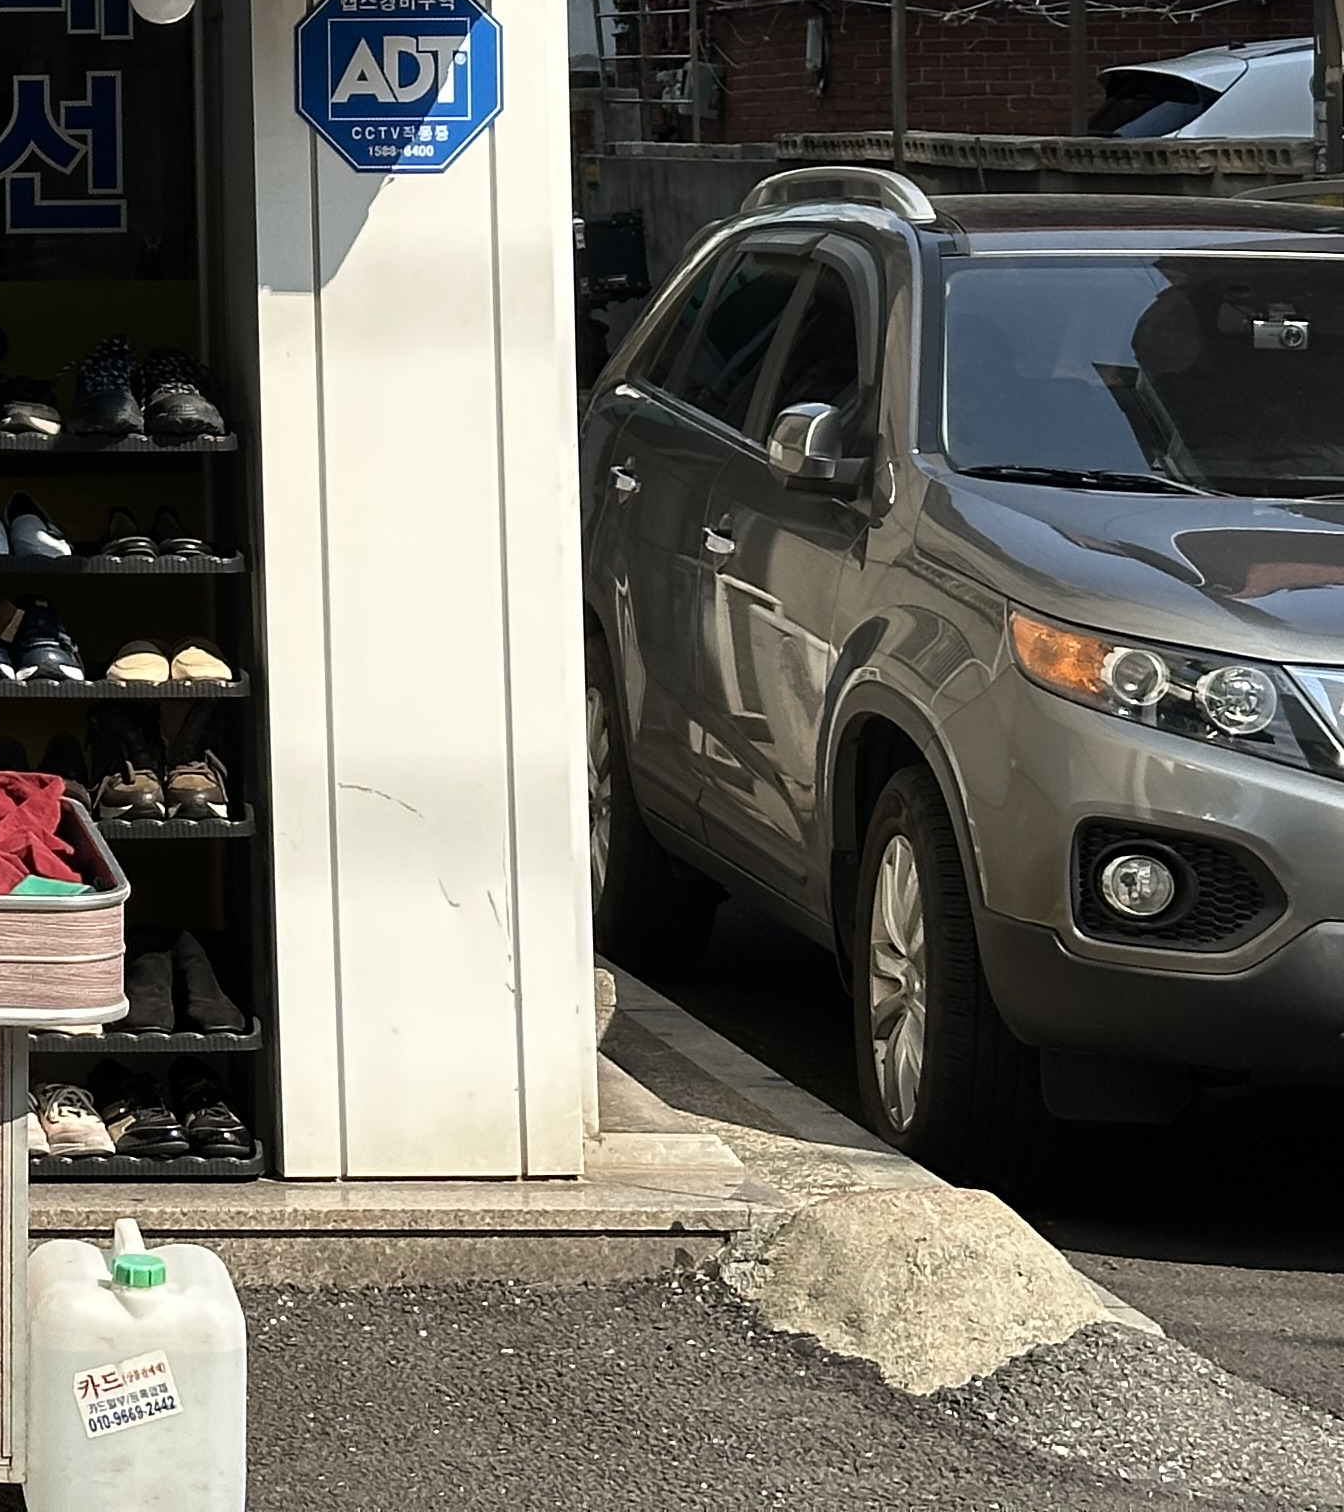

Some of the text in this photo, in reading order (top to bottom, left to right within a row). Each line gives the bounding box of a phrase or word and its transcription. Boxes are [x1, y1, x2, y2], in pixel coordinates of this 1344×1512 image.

[330, 35, 471, 104] ADT
[78, 1372, 123, 1399] 카드
[88, 1395, 177, 1433] 010-9669-2442
